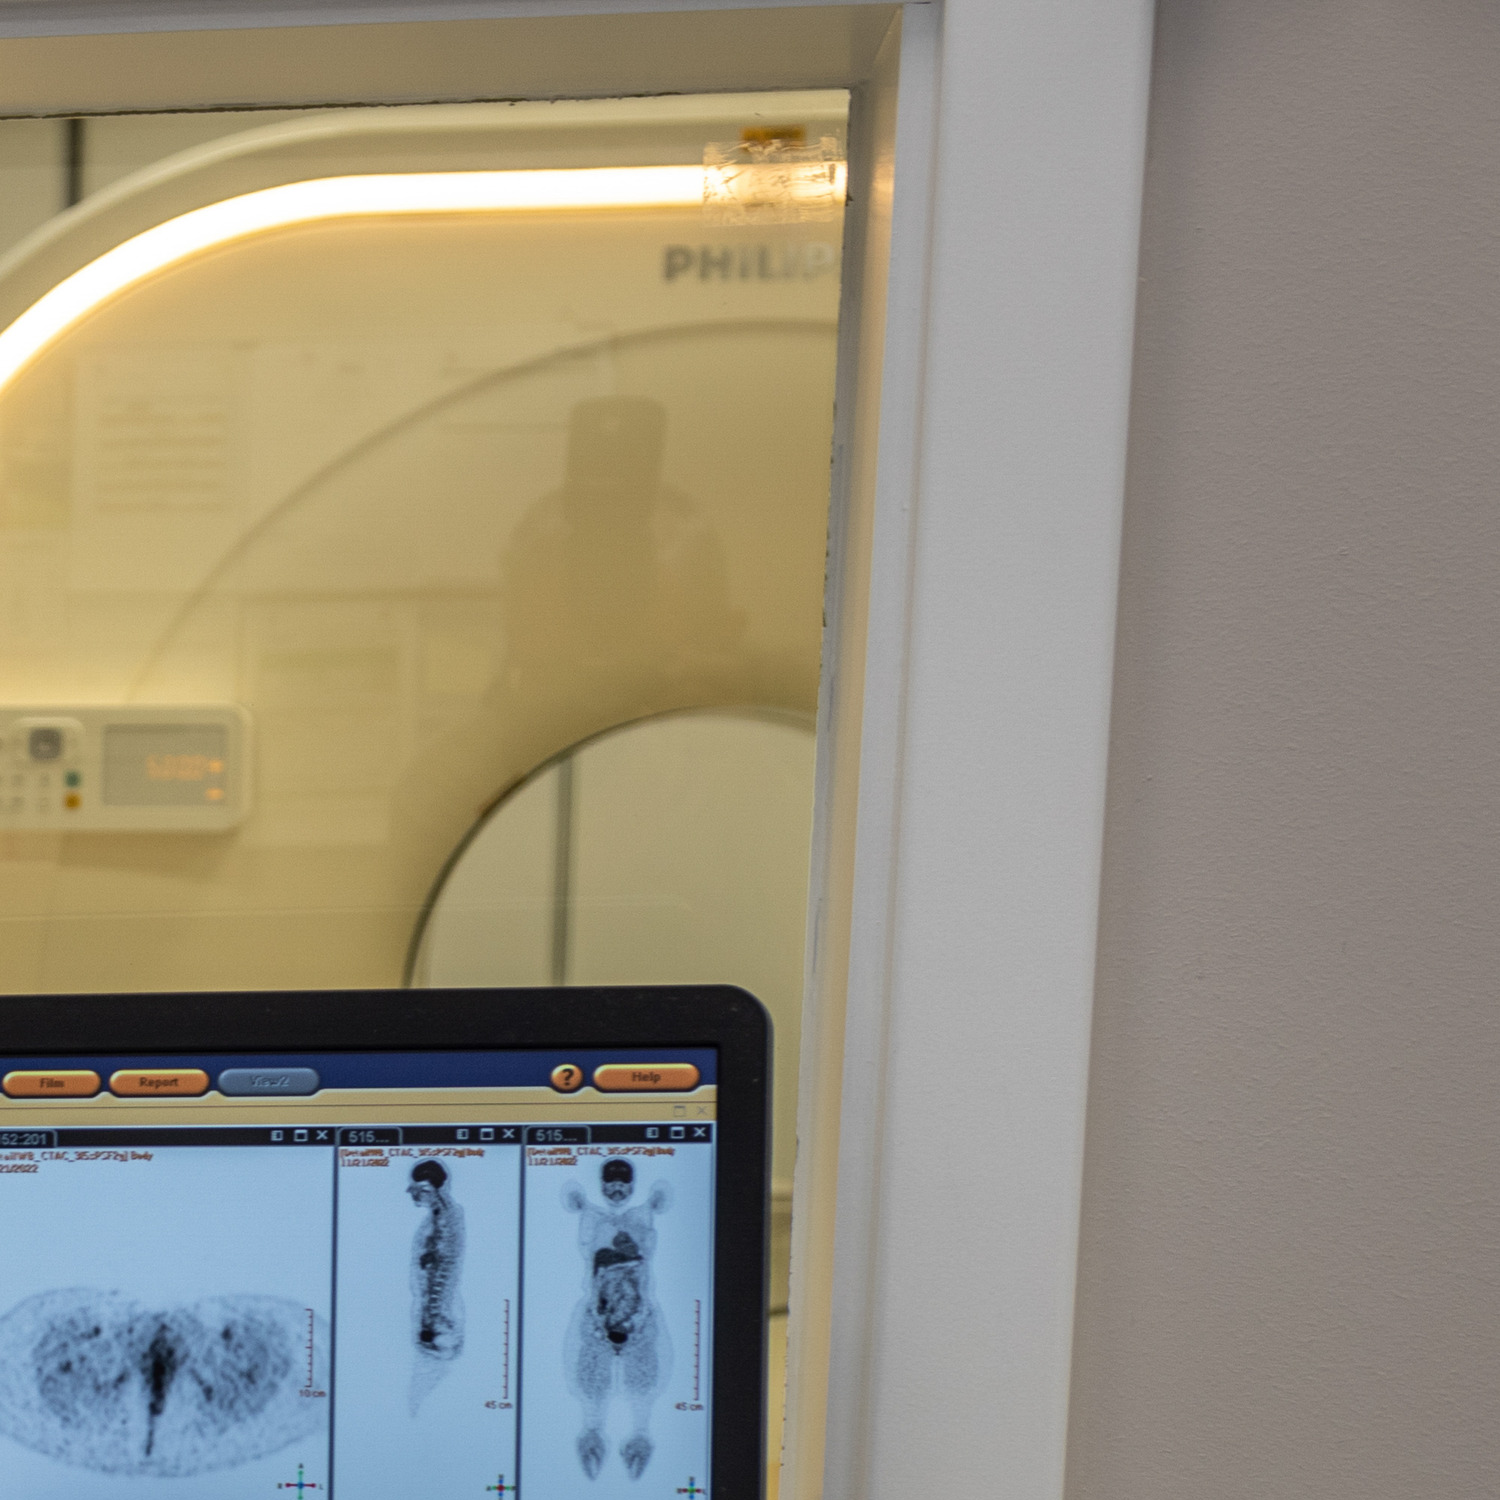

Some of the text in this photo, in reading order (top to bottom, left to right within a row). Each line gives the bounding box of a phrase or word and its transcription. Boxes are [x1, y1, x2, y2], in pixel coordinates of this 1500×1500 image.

[39, 1077, 65, 1089] Film
[139, 1076, 179, 1090] Report
[562, 1068, 574, 1086] ?
[631, 1071, 662, 1084] Help
